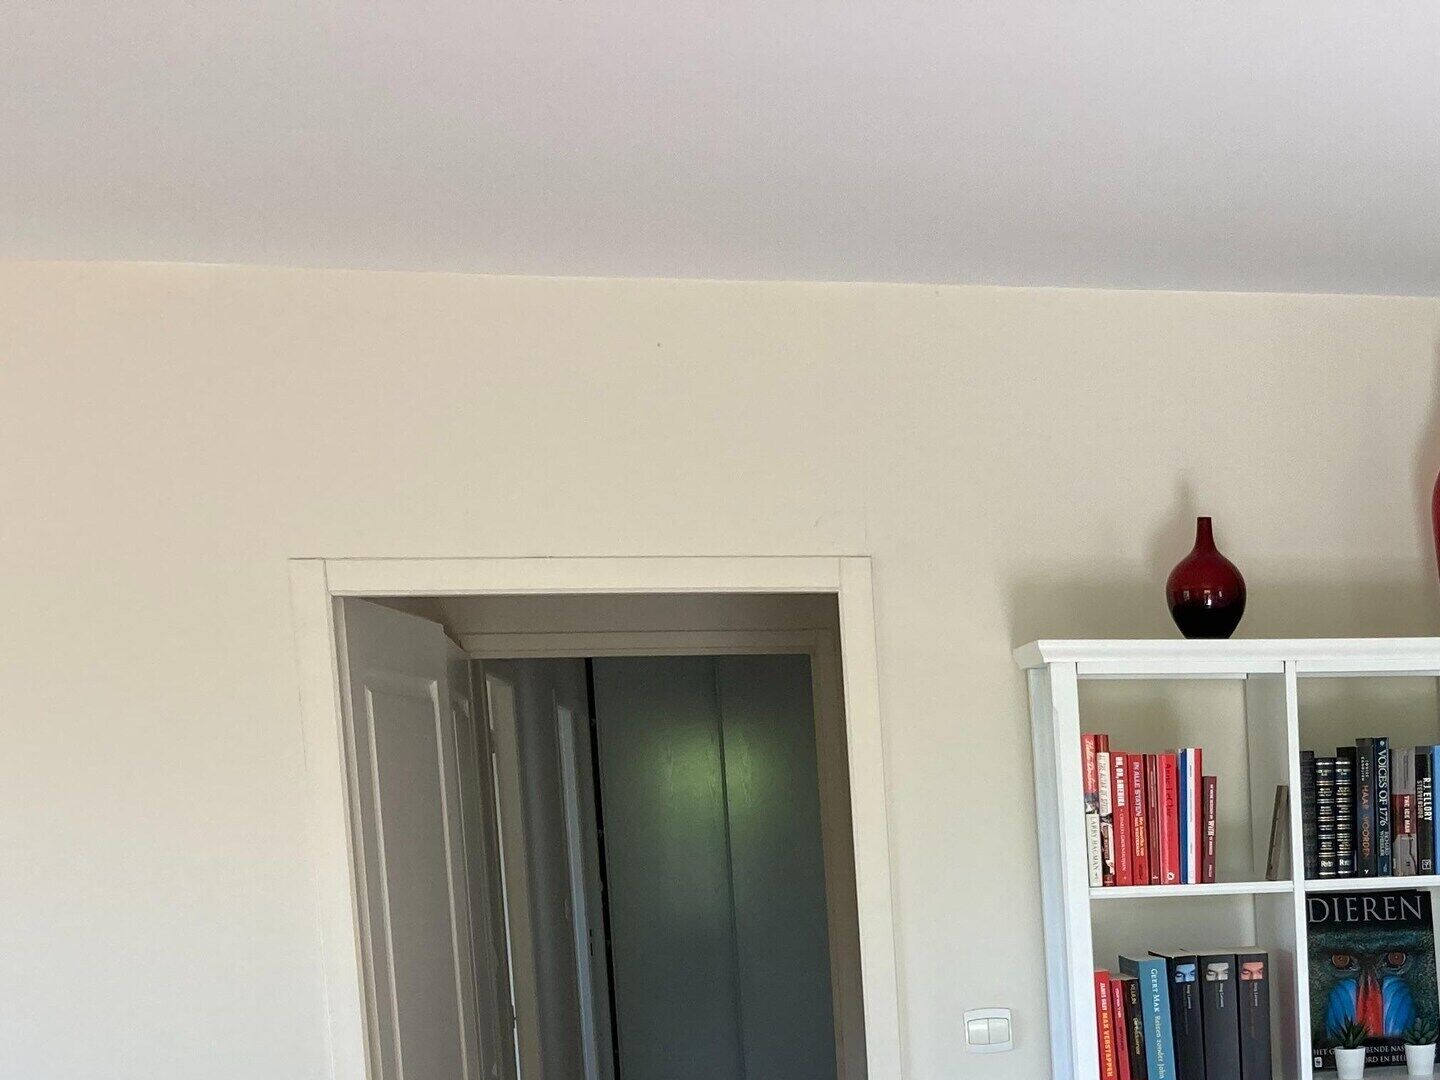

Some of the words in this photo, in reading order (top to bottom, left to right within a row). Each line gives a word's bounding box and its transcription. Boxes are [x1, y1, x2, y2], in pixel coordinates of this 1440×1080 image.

[1377, 749, 1388, 789] VOICES
[1422, 778, 1432, 791] R.J.
[1378, 791, 1387, 805] OF
[1423, 792, 1432, 821] ELLORY
[1090, 817, 1098, 839] LARRY
[1379, 808, 1389, 827] 1776
[1307, 895, 1422, 923] DIEREN
[1150, 969, 1159, 993] GEERT
[1152, 994, 1160, 1013] MAK
[1102, 1012, 1110, 1029] MAX
[1154, 1016, 1162, 1038] Reizen
[1103, 1031, 1113, 1077] VERSTAPPEN
[1156, 1040, 1164, 1062] zonder
[1157, 1063, 1165, 1080] John
